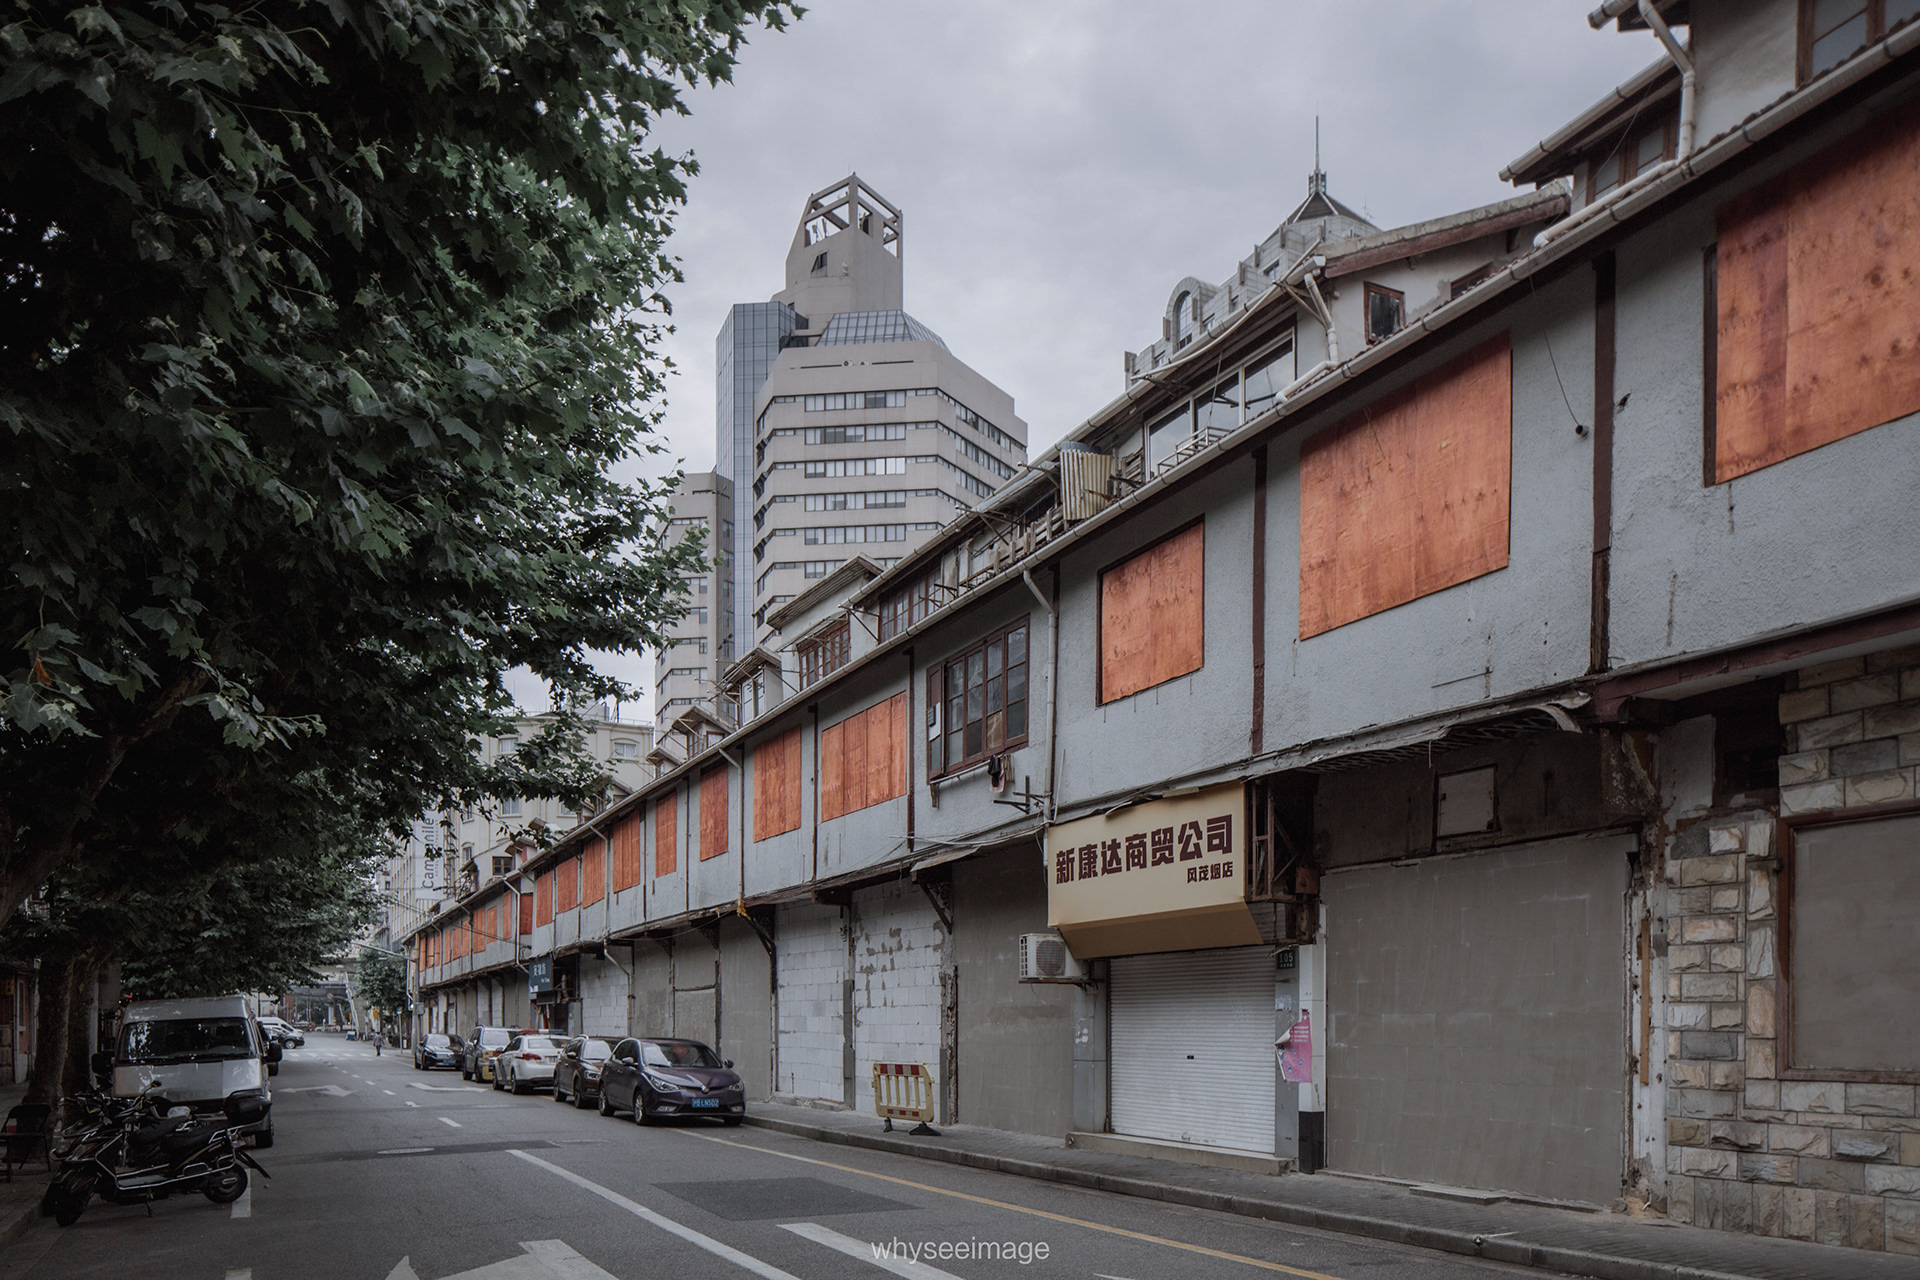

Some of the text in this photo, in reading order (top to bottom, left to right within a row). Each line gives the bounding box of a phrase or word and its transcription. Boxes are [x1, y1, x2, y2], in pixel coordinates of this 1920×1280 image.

[422, 818, 434, 889] Camanile
[1056, 814, 1232, 884] 新康达商贸公司
[1187, 861, 1233, 884] 风茂烟店
[1280, 952, 1293, 963] 105
